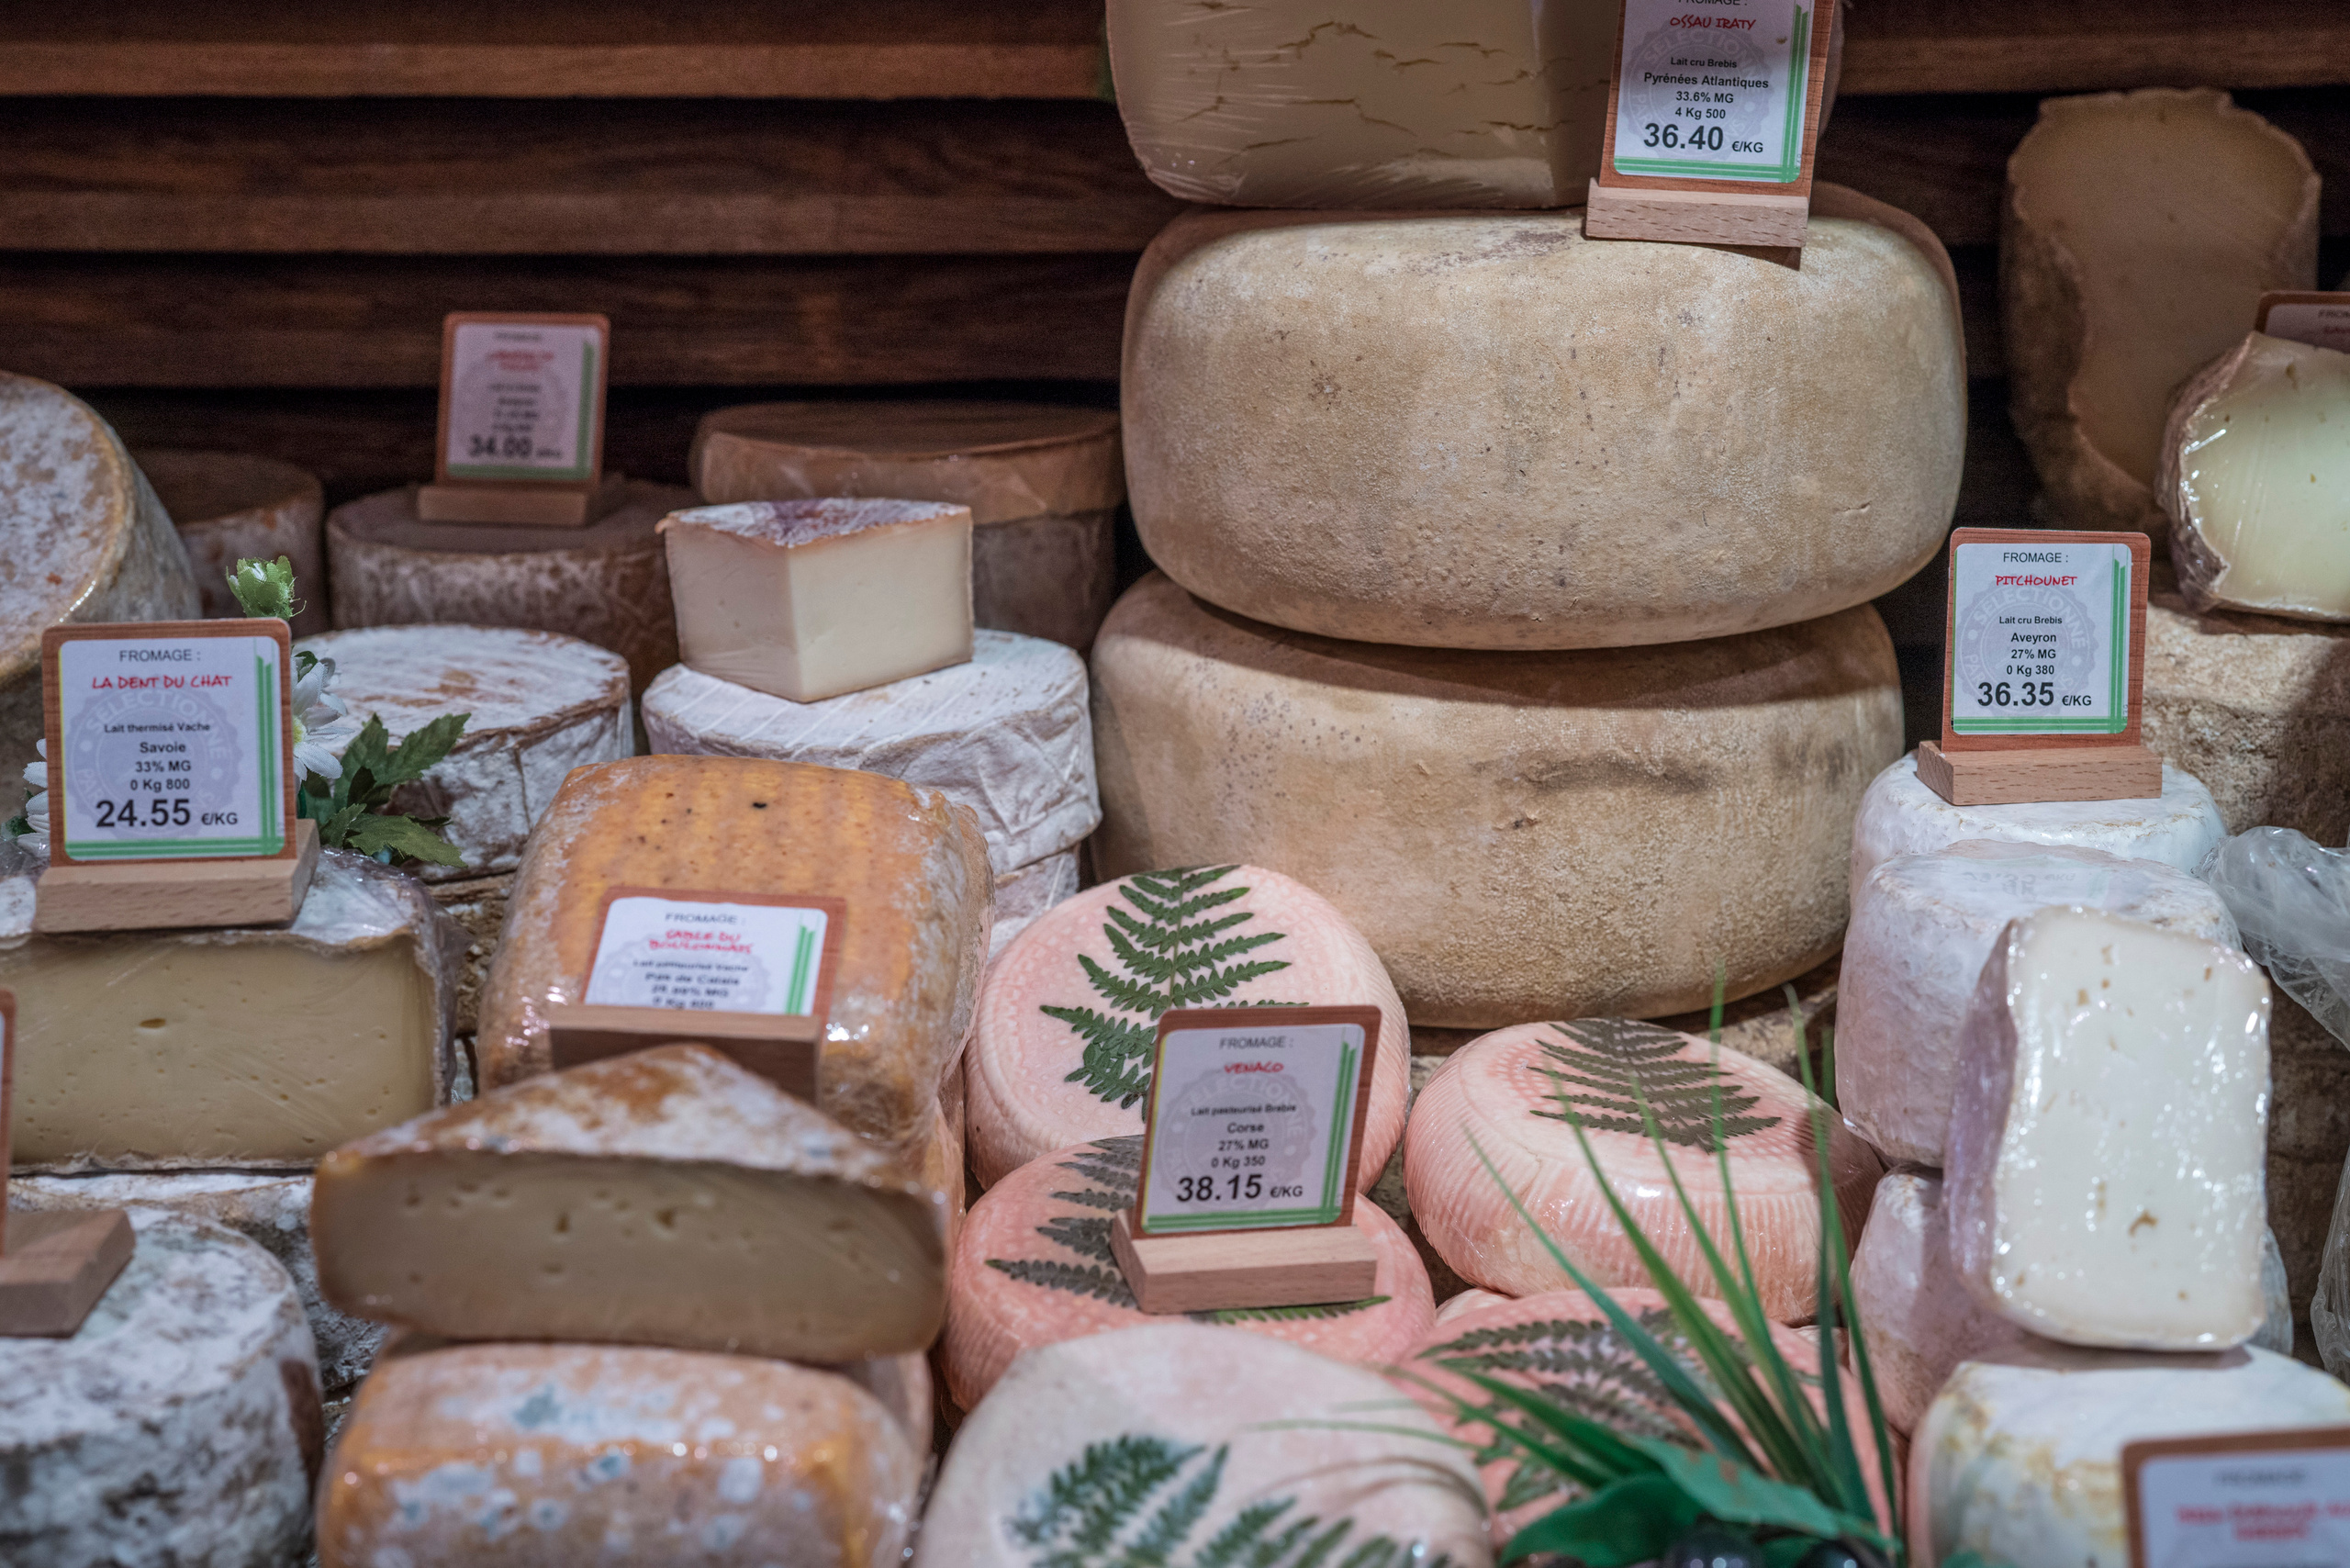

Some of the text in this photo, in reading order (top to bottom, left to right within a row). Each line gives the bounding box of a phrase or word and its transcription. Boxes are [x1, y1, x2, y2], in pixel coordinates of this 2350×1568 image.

[1670, 14, 1757, 30] OSSAU IRATY
[1671, 57, 1738, 68] Lait cru Brebis
[1644, 72, 1769, 89] Pyrénées Atlantiques
[1675, 90, 1734, 103] 33.6% MG
[1674, 107, 1726, 120] 4 Kg 500
[1643, 122, 1724, 151] 36.40
[1731, 140, 1764, 153] €/KG
[2003, 553, 2063, 563] FROMAGE
[1996, 575, 2078, 587] PITCHOUNET
[1999, 616, 2016, 624] Lait
[2034, 616, 2063, 624] Brebis
[2010, 633, 2057, 644] Aveyron
[119, 649, 192, 662] FROMAGE
[2011, 649, 2056, 659] 27% MG
[2007, 666, 2055, 678] 0 Kg 380
[93, 675, 232, 689] LA DENT DU CHAT
[1977, 682, 2054, 707] 36.35
[2062, 695, 2092, 706] €/KG
[105, 722, 210, 734] Lait thermisé Vache
[140, 742, 186, 754] Savoie
[136, 760, 192, 772] 33% MG
[130, 778, 190, 792] 0 Kg 800
[95, 799, 191, 828] 24.55
[201, 812, 239, 825] €/KG
[665, 913, 738, 925] FROMAGE
[1219, 1036, 1285, 1050] FROMAGE
[1225, 1061, 1284, 1073] VENACO
[1192, 1107, 1210, 1116] Lait
[1227, 1123, 1264, 1134] Corse
[1218, 1139, 1269, 1152] 27% MG
[1211, 1156, 1265, 1170] 0 Kg 350
[1176, 1174, 1303, 1203] 38.15 €/KG
